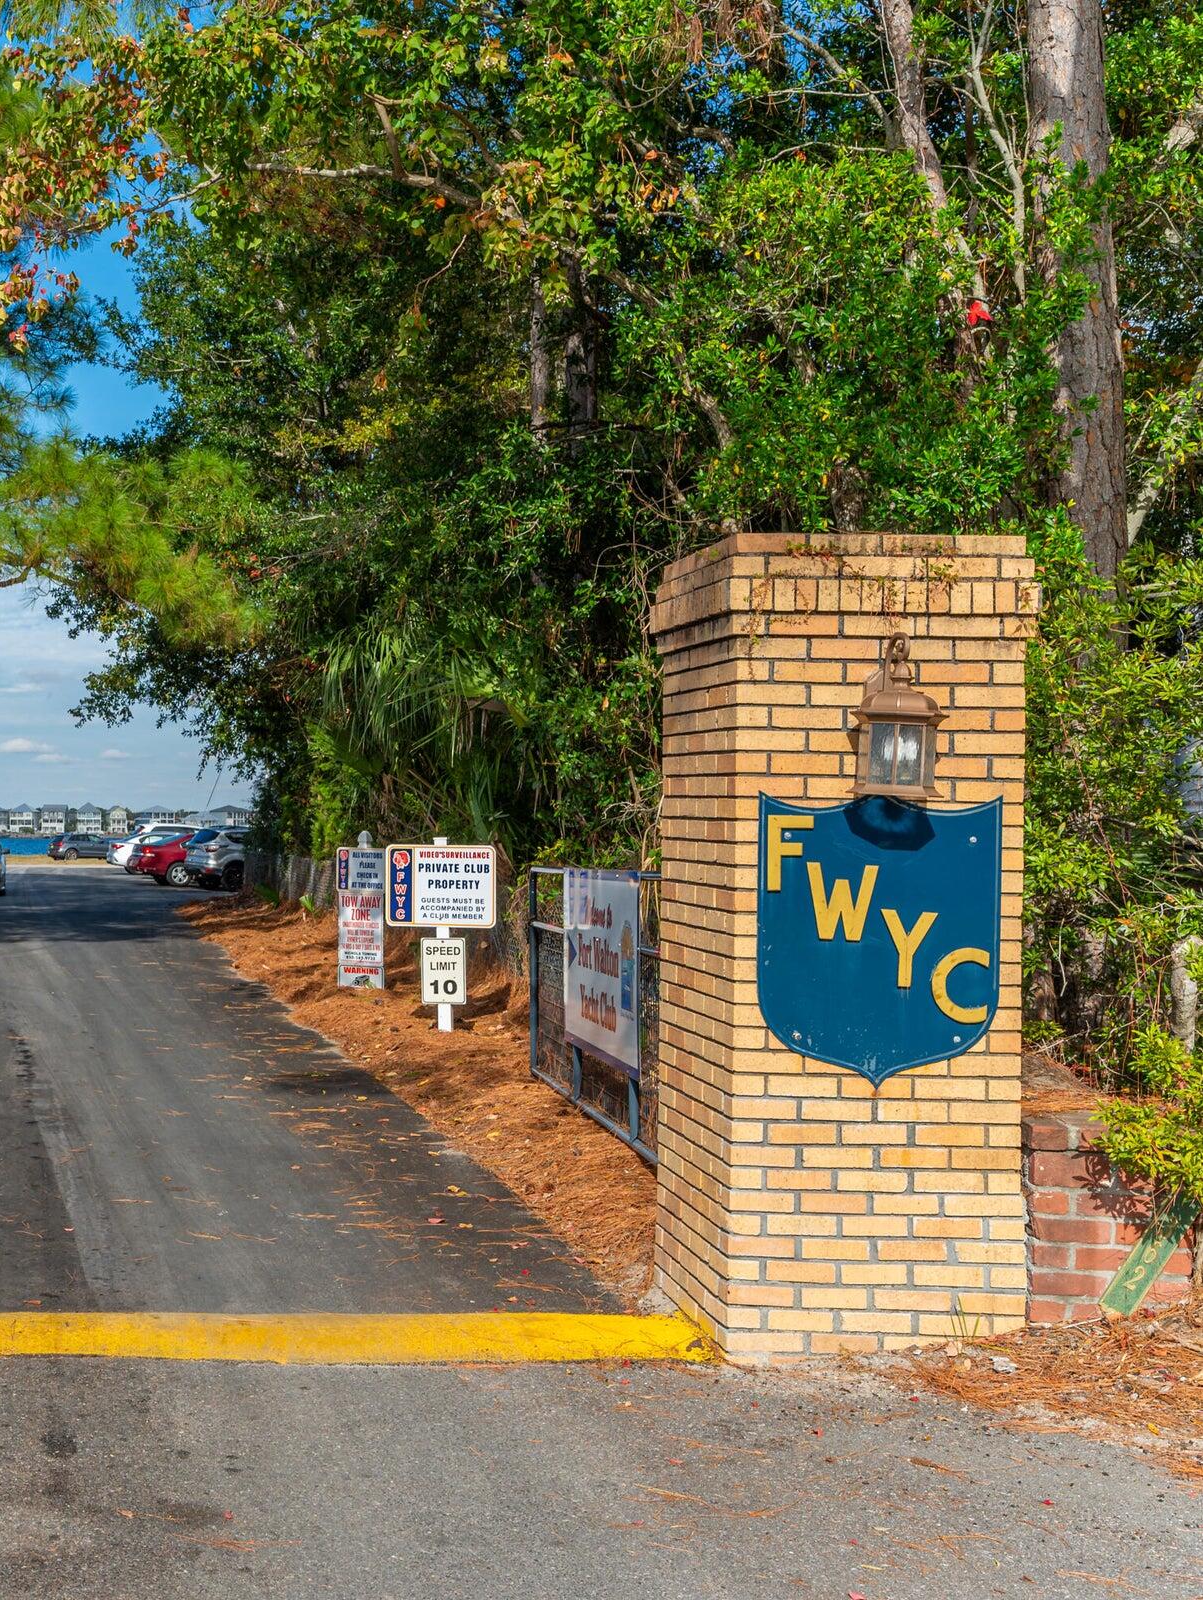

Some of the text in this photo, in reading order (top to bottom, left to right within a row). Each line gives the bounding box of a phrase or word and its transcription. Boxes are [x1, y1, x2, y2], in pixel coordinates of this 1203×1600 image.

[419, 851, 490, 860] VIDEO SURVEILLANCE
[418, 863, 490, 874] PRIVATE CLUB
[428, 880, 480, 890] PROPERTY
[394, 871, 407, 920] FWYC
[341, 896, 381, 909] TOW AWAY
[351, 909, 371, 921] ZONE
[767, 814, 991, 1025] FWYC
[425, 946, 461, 956] SPEED
[578, 933, 619, 979] Fort Walton
[343, 966, 380, 975] WARNING
[429, 961, 457, 971] LIMIT
[429, 979, 458, 995] 10
[579, 984, 617, 1033] Yacht Club
